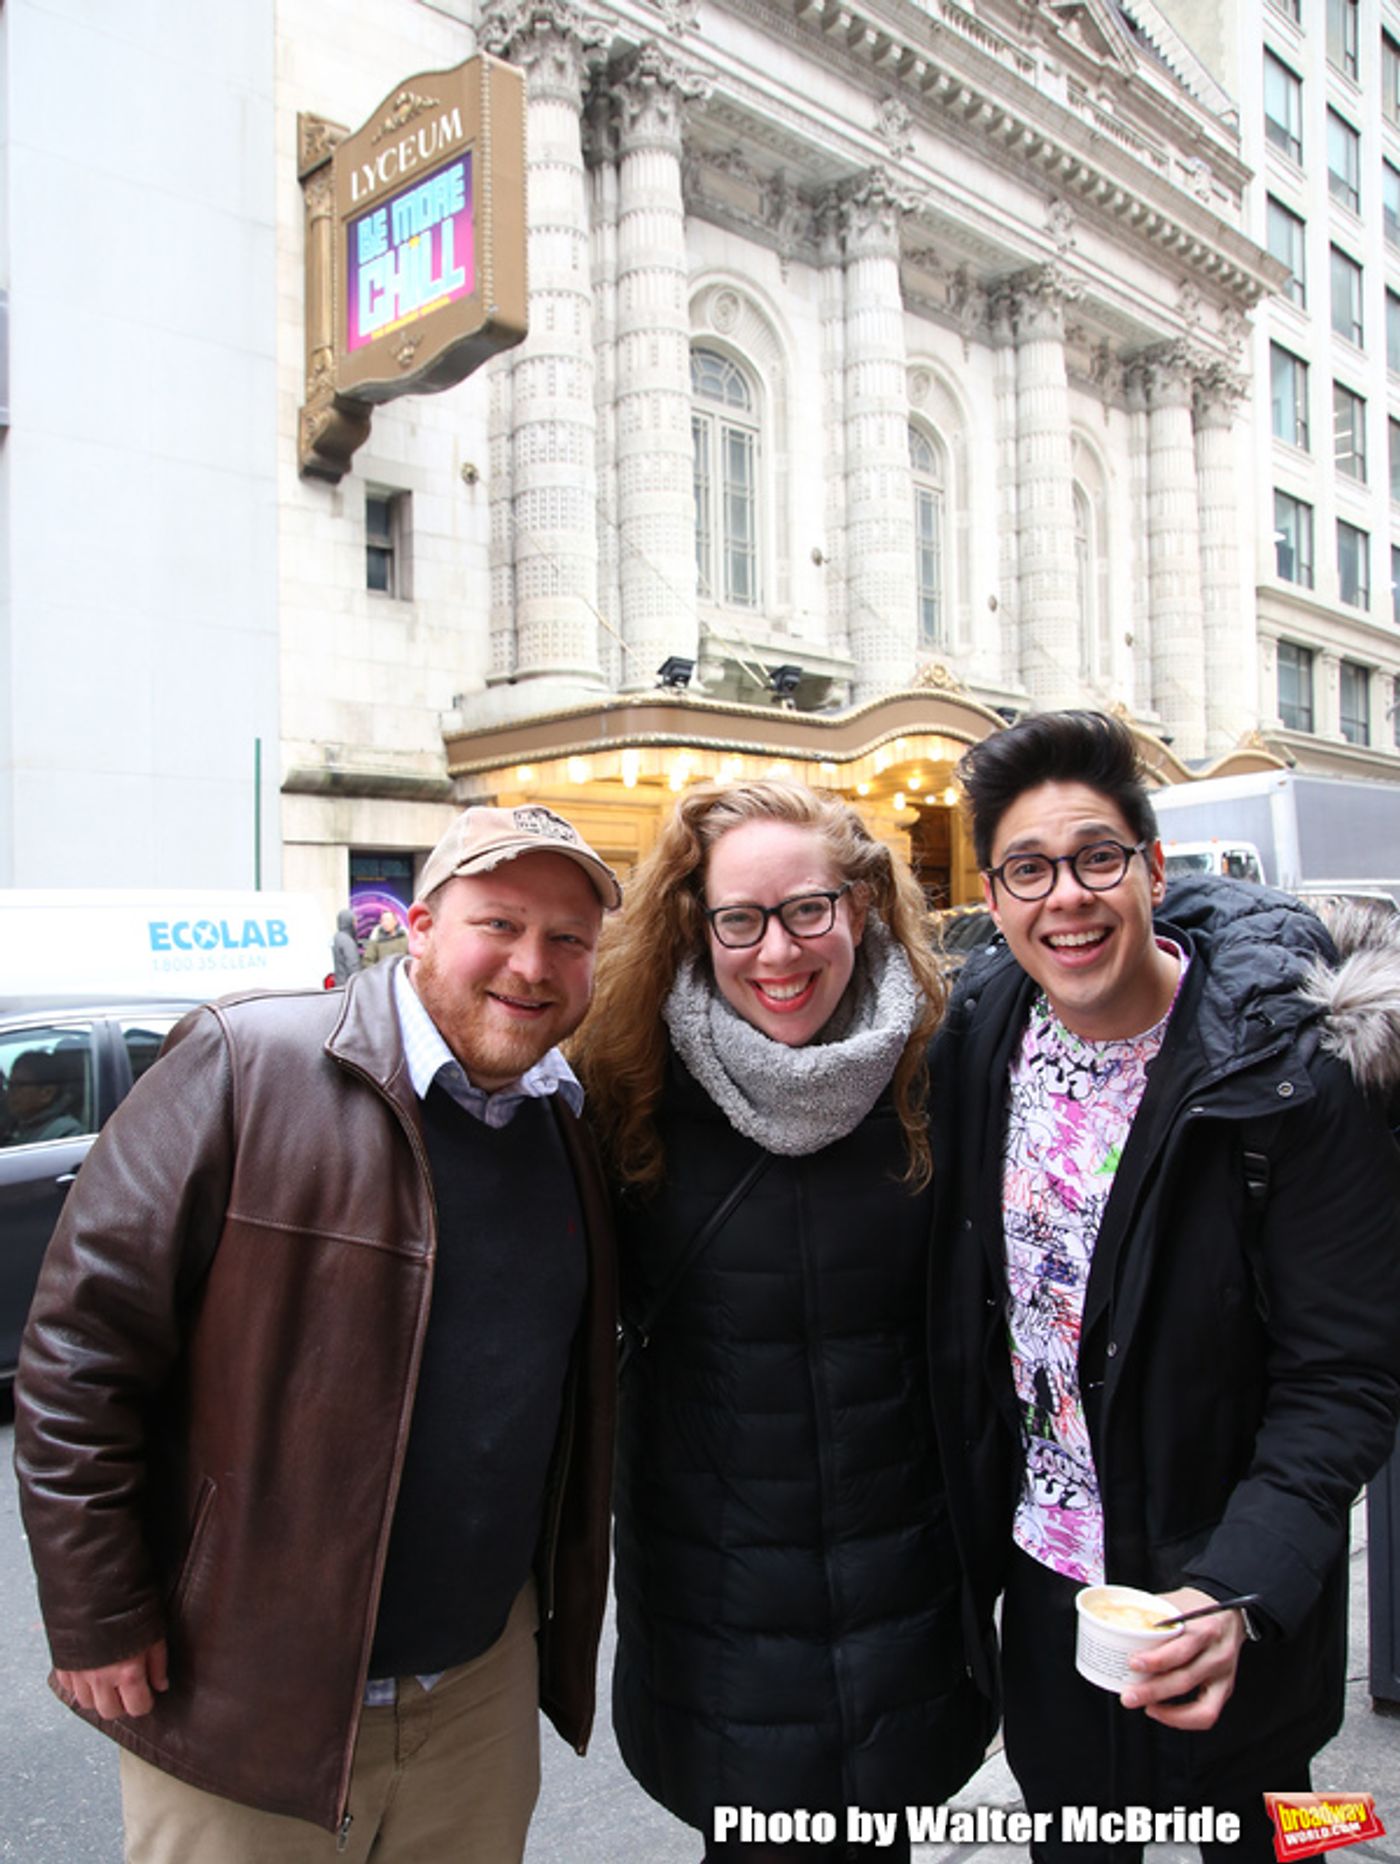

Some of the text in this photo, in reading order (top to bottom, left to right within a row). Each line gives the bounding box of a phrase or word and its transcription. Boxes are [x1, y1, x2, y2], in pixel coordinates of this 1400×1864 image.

[351, 108, 462, 201] LYCEUM
[357, 163, 465, 265] BE MORE
[358, 217, 465, 337] CHILL
[149, 919, 289, 951] ECOLAB
[220, 954, 268, 970] CLEAN
